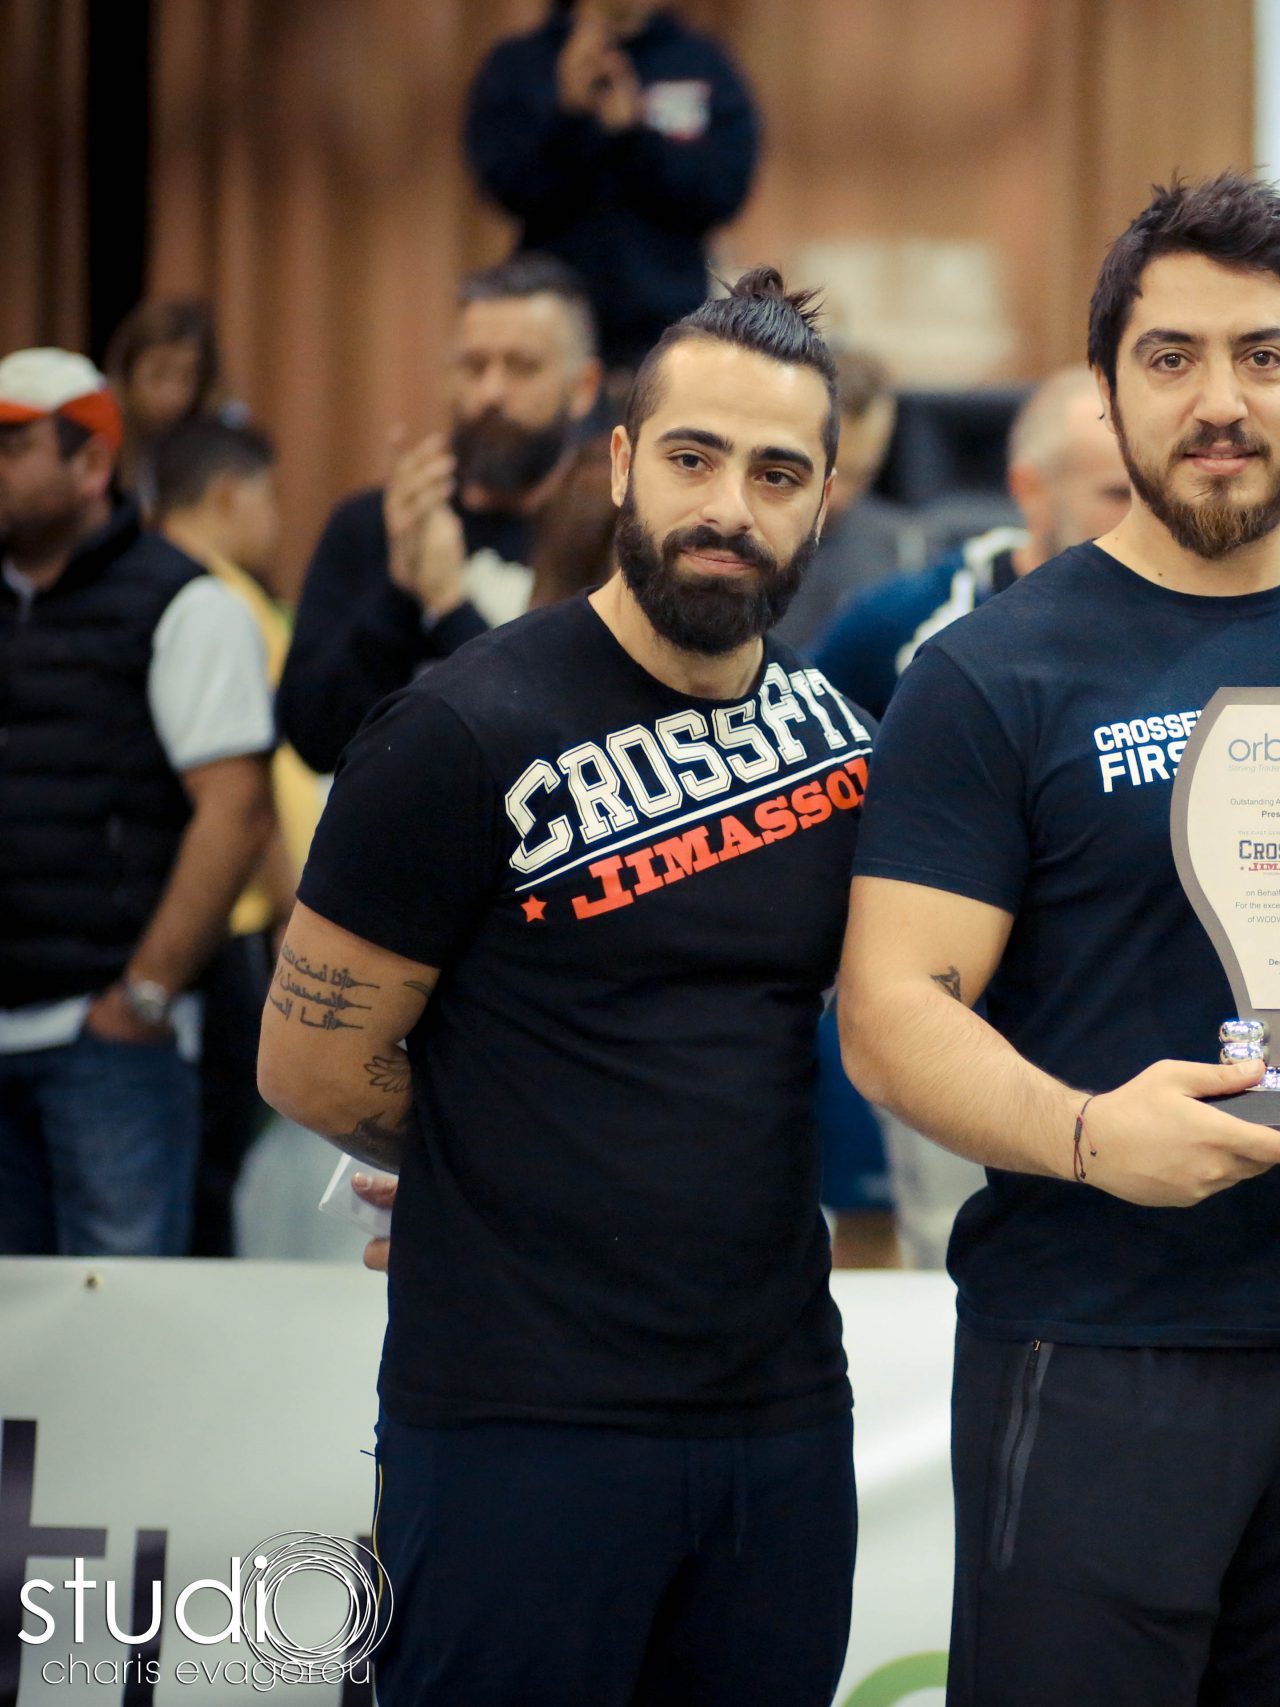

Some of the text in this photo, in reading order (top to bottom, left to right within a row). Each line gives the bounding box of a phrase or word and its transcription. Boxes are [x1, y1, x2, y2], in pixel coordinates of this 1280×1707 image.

[504, 661, 872, 874] CROSSFIT
[1230, 798, 1274, 807] Outstanding
[1257, 889, 1280, 897] Behalf
[1247, 916, 1256, 924] of
